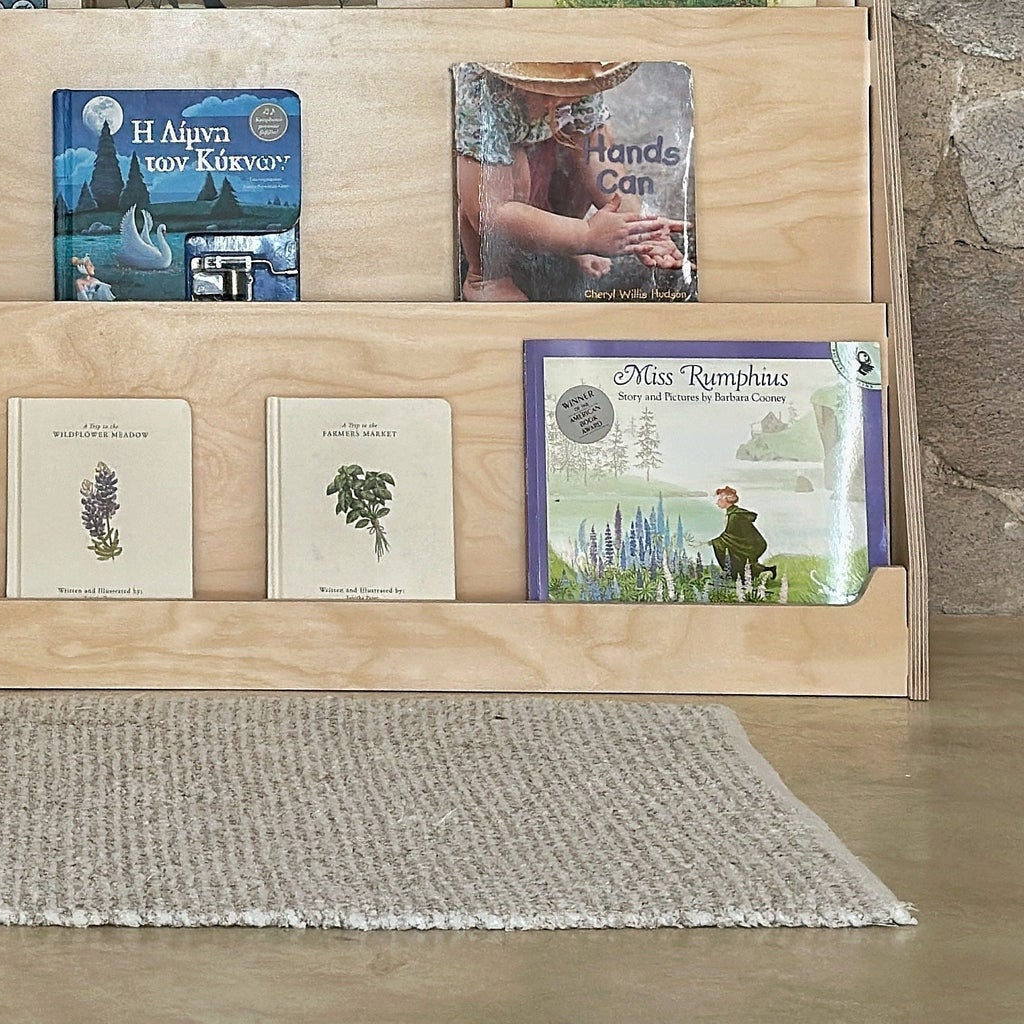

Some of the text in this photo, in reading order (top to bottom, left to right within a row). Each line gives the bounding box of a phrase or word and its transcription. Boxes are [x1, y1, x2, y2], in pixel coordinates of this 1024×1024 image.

[131, 119, 230, 150] Η Λίμνη
[145, 148, 291, 171] των Κύκνων
[583, 133, 680, 166] Hands
[597, 169, 654, 195] Can
[584, 288, 687, 300] Cheryl Willis Hudson
[614, 364, 789, 392] Miss Rumphius
[561, 390, 595, 409] WINNER
[618, 392, 787, 404] Story and Pictures by Barbara Cooney
